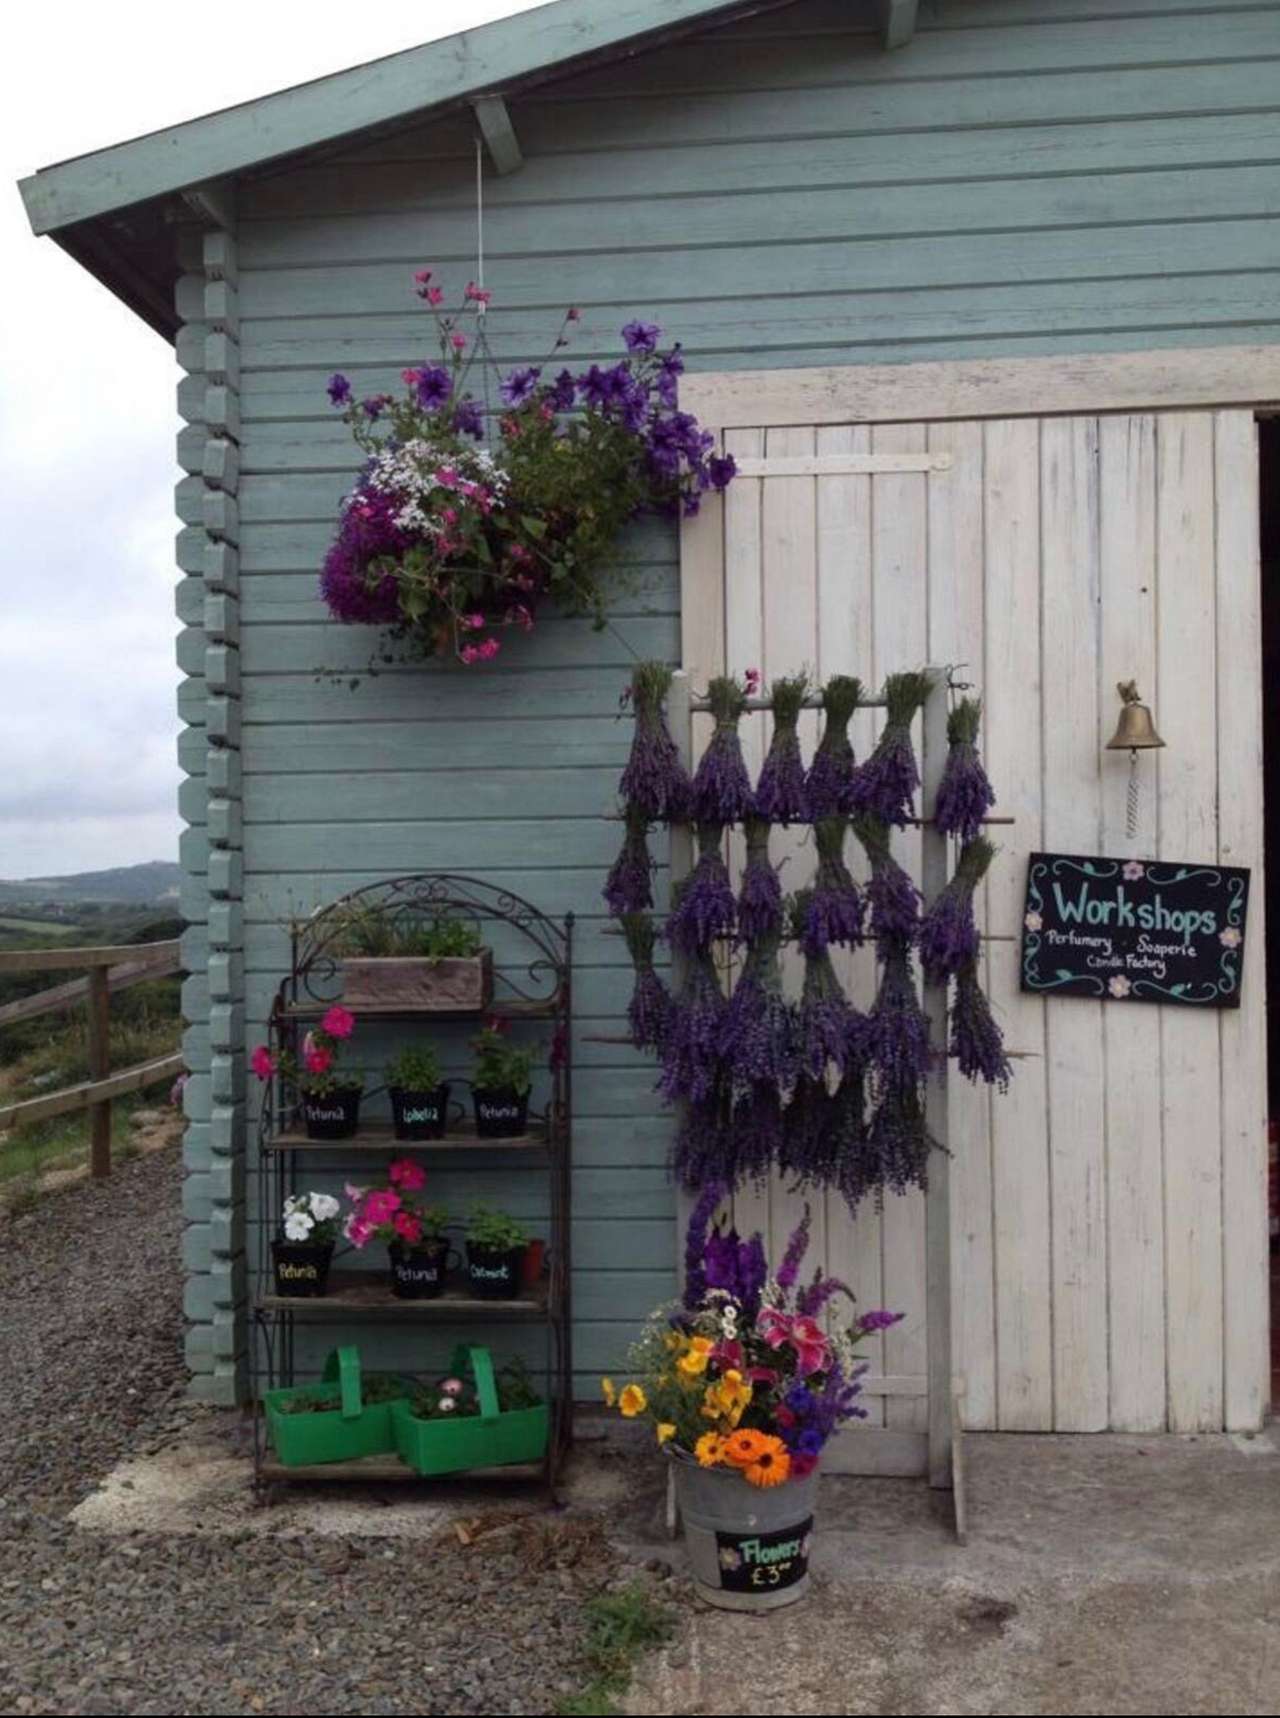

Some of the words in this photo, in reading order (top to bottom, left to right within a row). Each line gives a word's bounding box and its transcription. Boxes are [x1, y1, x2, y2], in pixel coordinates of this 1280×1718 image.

[1052, 881, 1217, 945] Workshops
[1046, 930, 1112, 955] Perfumery
[1136, 934, 1198, 957] Soaperie
[1125, 954, 1166, 979] Factory
[739, 1539, 801, 1563] Flowers
